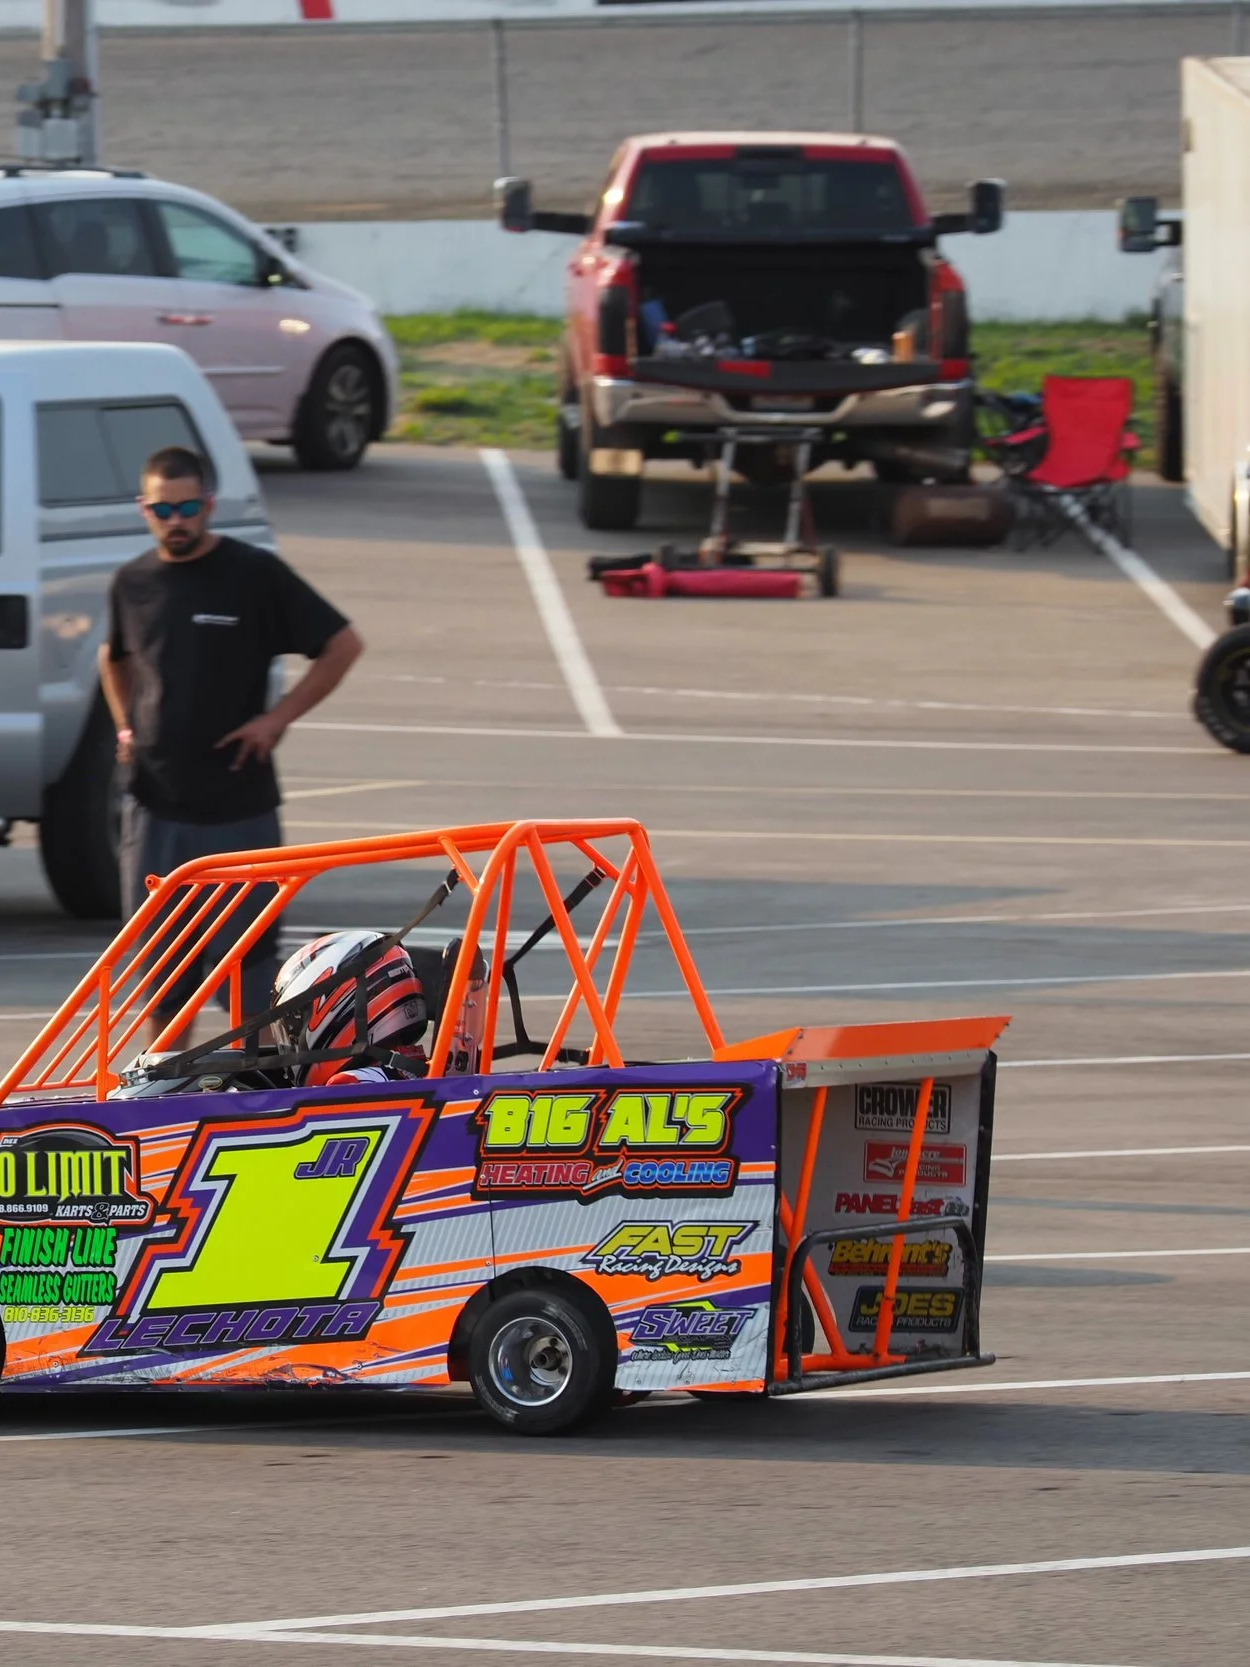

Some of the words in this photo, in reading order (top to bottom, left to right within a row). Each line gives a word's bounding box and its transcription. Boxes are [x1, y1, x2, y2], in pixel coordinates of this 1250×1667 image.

[599, 1093, 732, 1146] AL'S
[858, 1116, 893, 1127] RACING
[895, 1118, 947, 1130] PROCTS
[2, 1137, 19, 1145] MI
[24, 1151, 127, 1203] LIMIT
[480, 1162, 591, 1186] HEATING
[587, 1159, 623, 1188] and
[623, 1161, 731, 1185] COOLING
[146, 1129, 384, 1312] 1
[294, 1137, 370, 1179] JR
[0, 1228, 69, 1265] FINISH
[72, 1228, 117, 1265] LINE
[595, 1226, 744, 1258] FAST
[831, 1237, 952, 1264] Behrnt's
[598, 1255, 664, 1279] Racing
[664, 1255, 738, 1280] Designs
[63, 1273, 115, 1303] GUTTERS
[84, 1301, 381, 1352] LECHOTA
